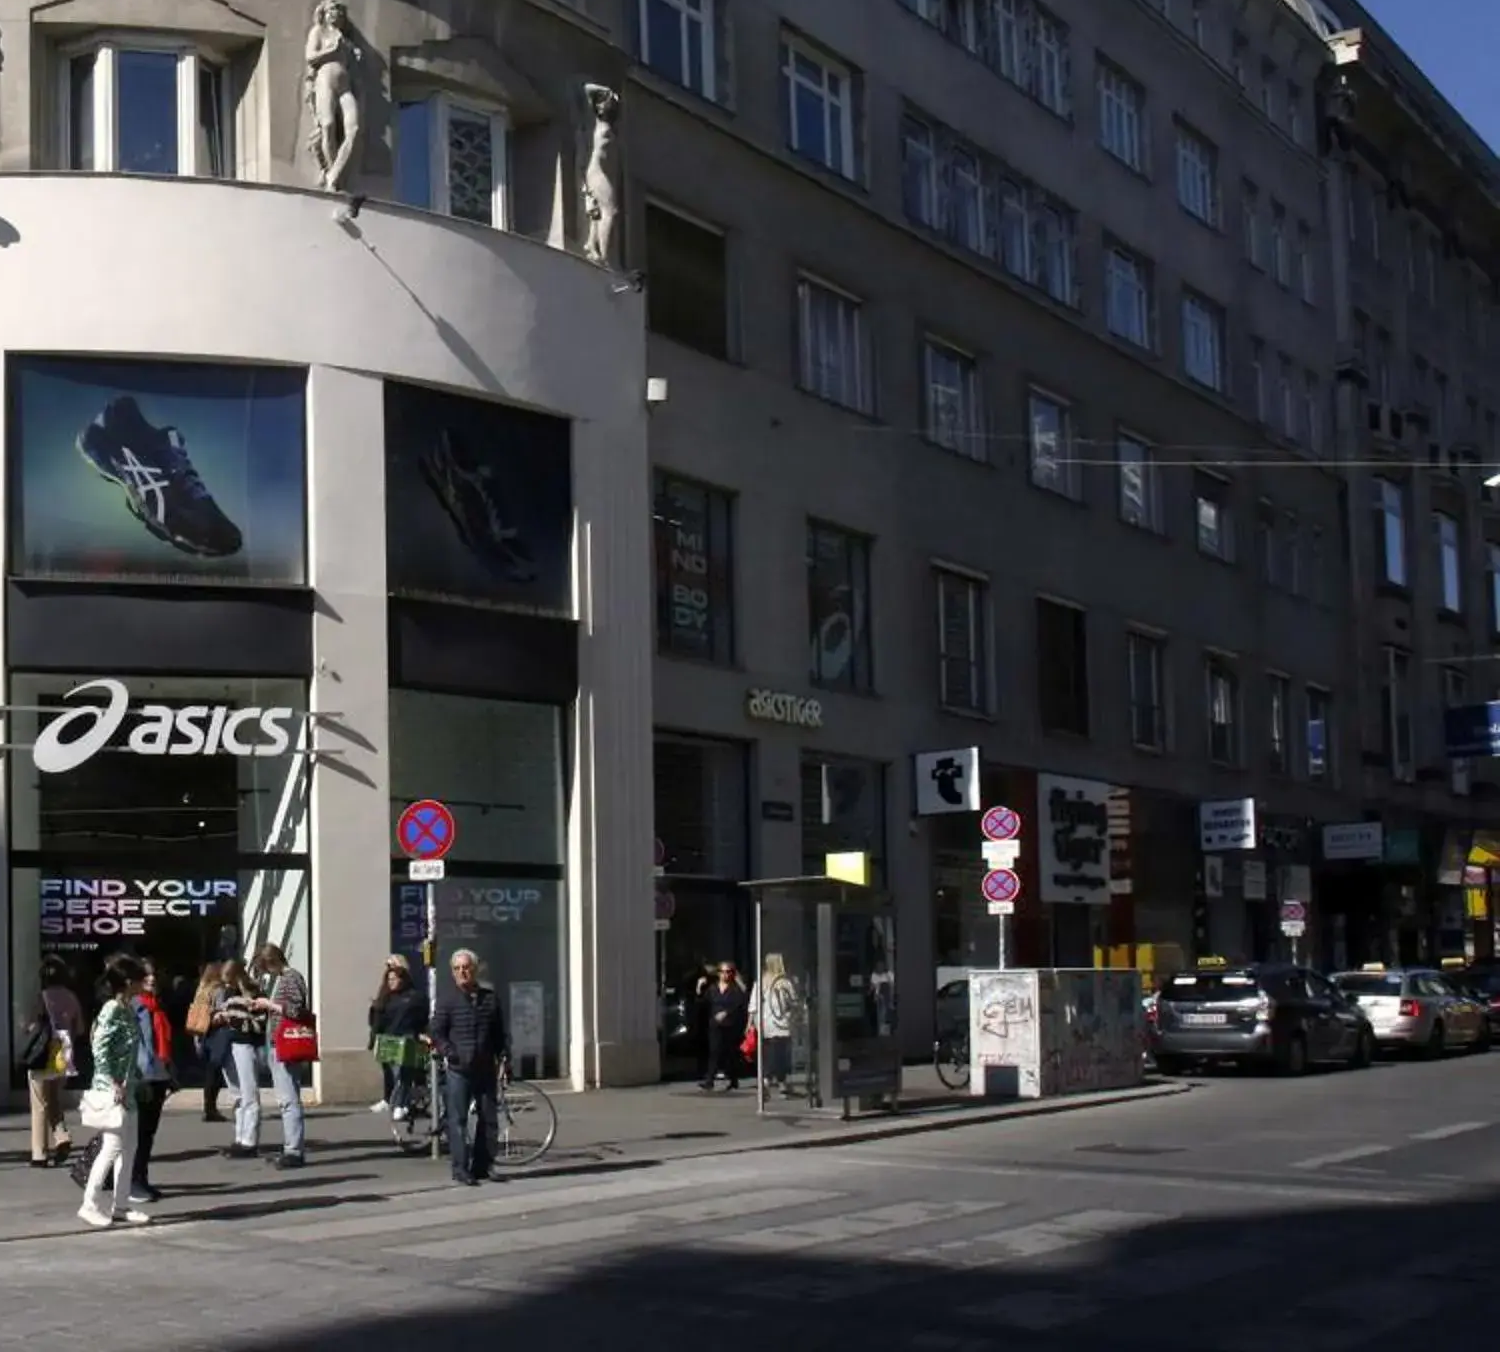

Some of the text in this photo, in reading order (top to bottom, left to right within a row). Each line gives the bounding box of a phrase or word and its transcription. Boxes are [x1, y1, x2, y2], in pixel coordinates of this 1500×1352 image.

[40, 879, 238, 898] FIND YOUR
[40, 899, 217, 917] PERFECT
[40, 917, 146, 935] SHOE
